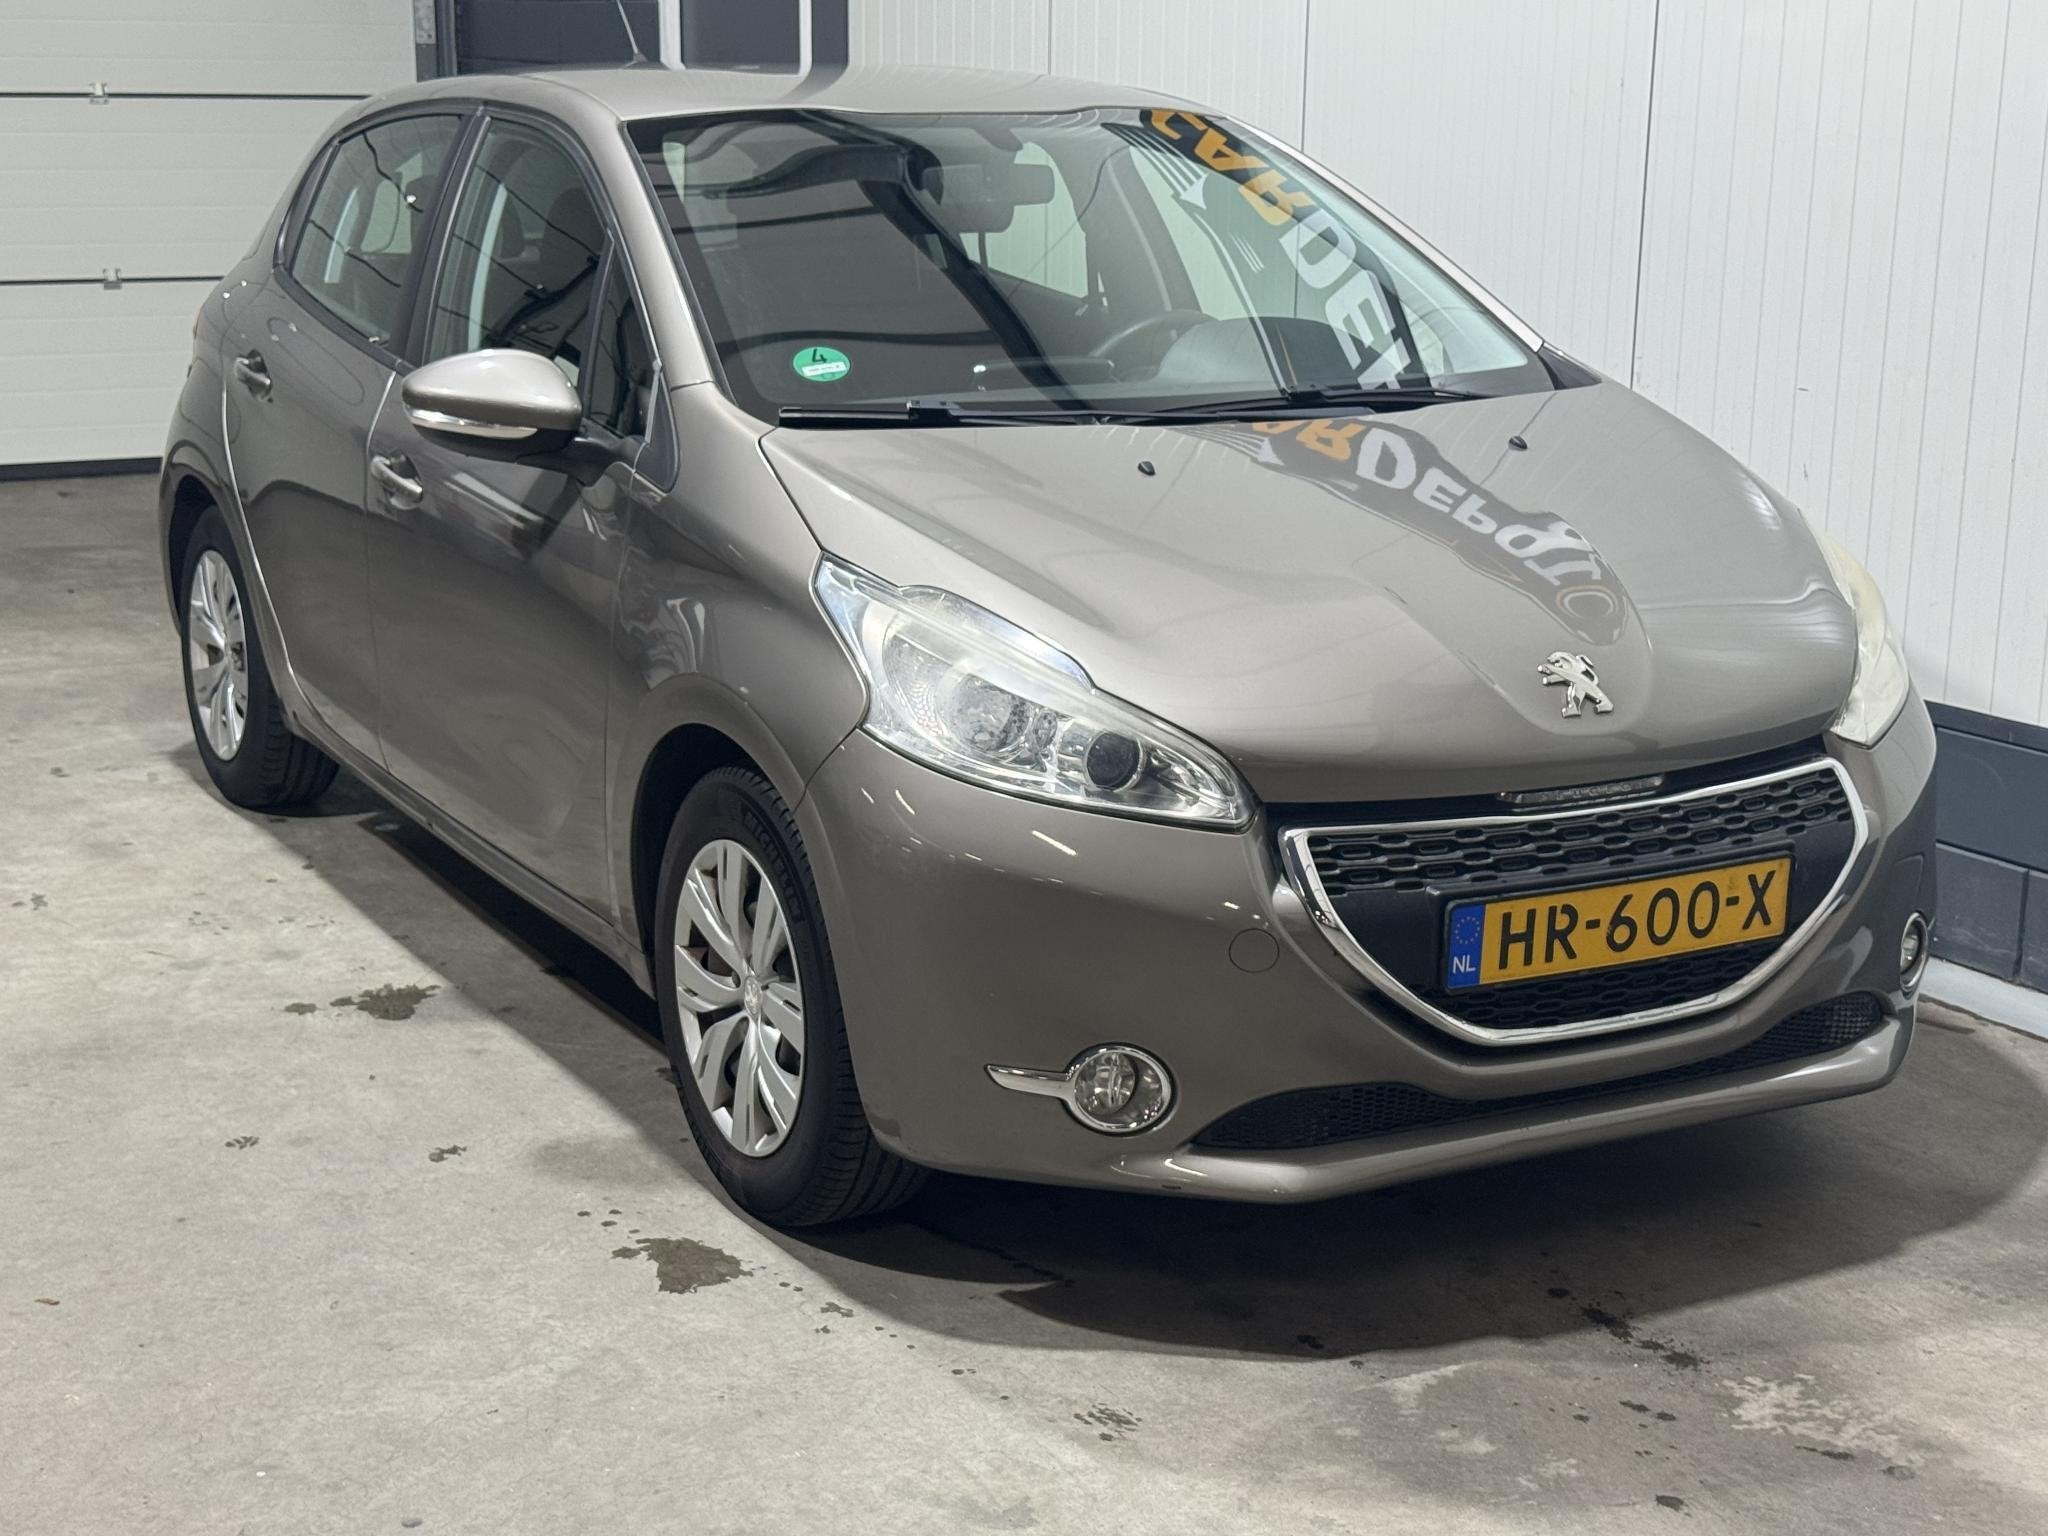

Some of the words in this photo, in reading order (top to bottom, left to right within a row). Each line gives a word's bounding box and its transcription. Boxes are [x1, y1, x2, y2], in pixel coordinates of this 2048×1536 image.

[812, 348, 827, 363] 4
[1498, 869, 1776, 971] HR-600-X
[1452, 954, 1477, 975] NL
